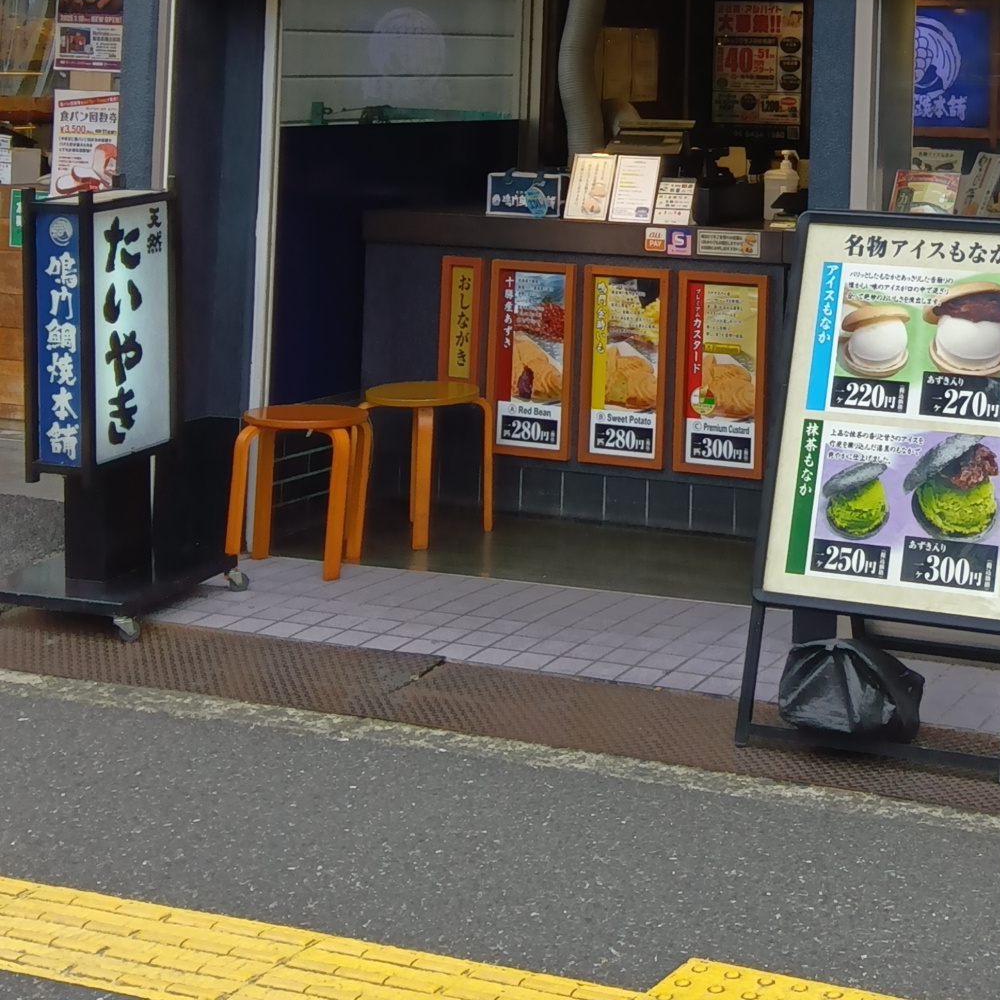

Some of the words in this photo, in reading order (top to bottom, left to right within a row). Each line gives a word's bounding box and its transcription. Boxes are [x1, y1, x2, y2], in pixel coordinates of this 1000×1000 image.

[60, 111, 117, 123] 食パン回数券
[147, 207, 162, 253] 天然
[503, 276, 514, 348] 十勝産あずき
[818, 264, 839, 344] アイスもなか
[103, 216, 143, 445] たいやき
[456, 274, 471, 367] おしながき
[45, 252, 79, 461] 鳴門鯛焼本舗
[927, 375, 964, 387] あずき入り
[844, 382, 896, 409] 220円
[942, 389, 999, 418] 270円
[518, 406, 532, 415] Red
[533, 407, 551, 417] Bean
[607, 413, 628, 424] Sweet
[629, 415, 652, 426] Potato
[511, 420, 549, 442] 280円
[605, 428, 644, 450] 280円
[703, 423, 728, 433] Premium
[728, 425, 750, 435] Custard
[701, 437, 743, 460] 300円
[799, 422, 819, 496] 抹茶もなか
[824, 545, 877, 574] 250円
[908, 540, 947, 552] あずき入り
[924, 554, 982, 587] 300円
